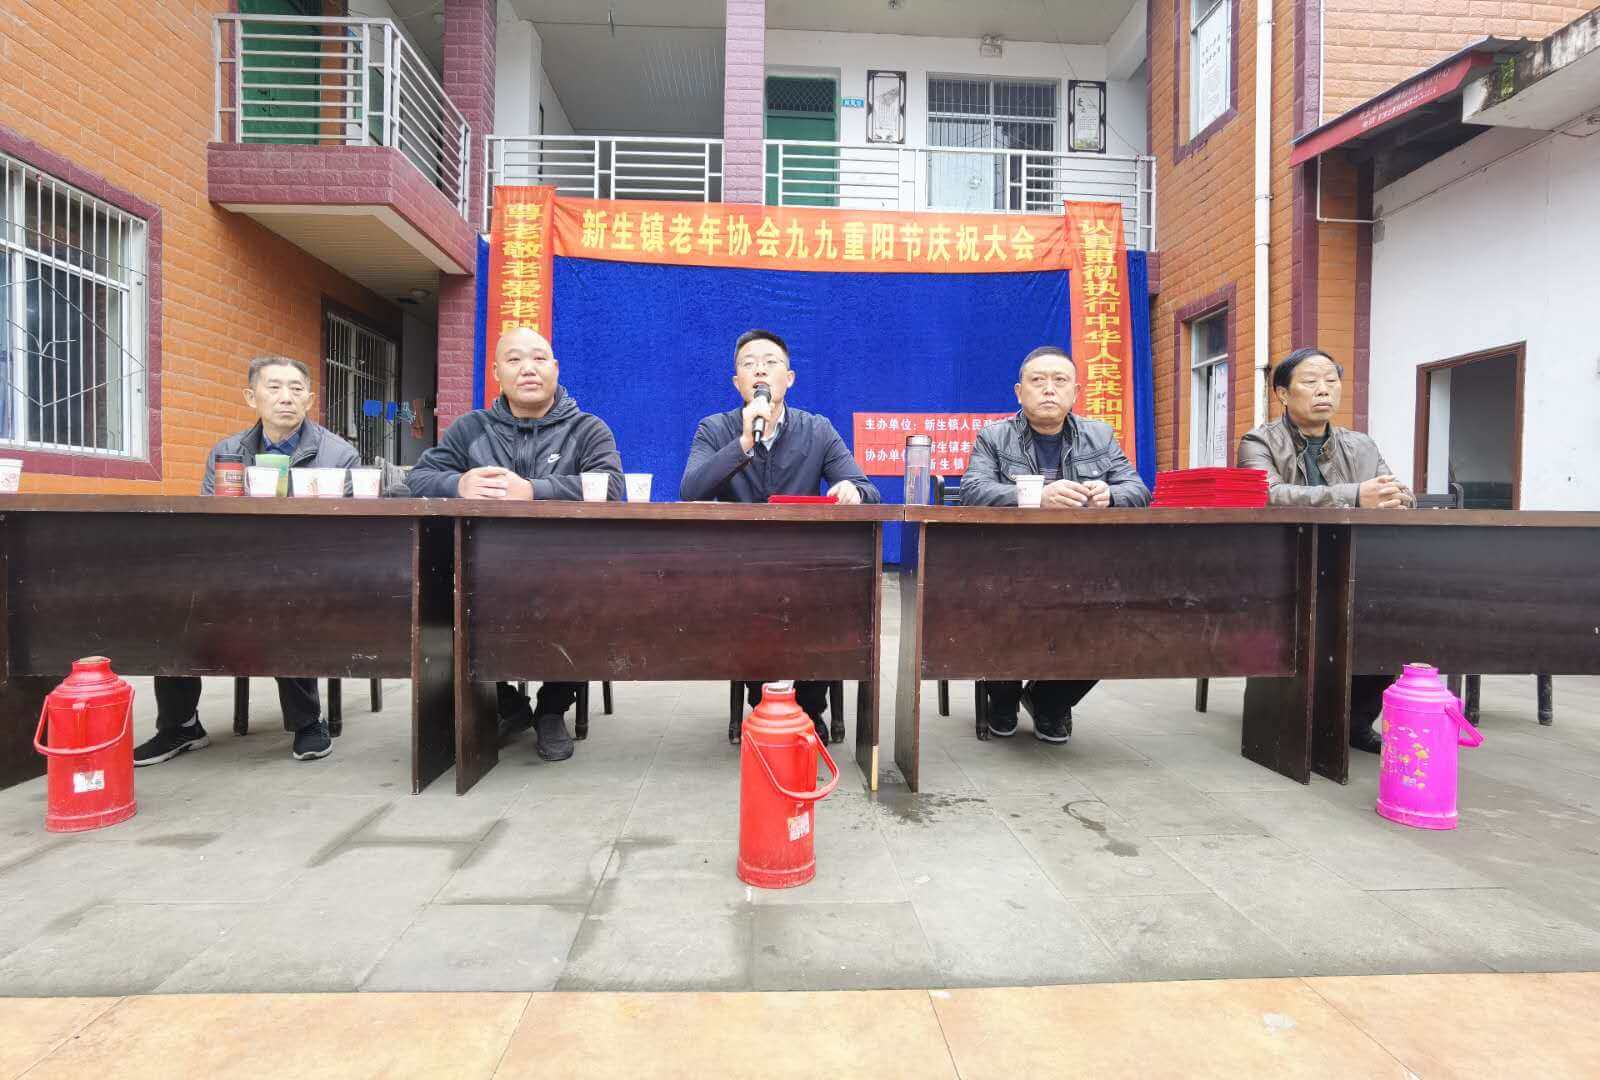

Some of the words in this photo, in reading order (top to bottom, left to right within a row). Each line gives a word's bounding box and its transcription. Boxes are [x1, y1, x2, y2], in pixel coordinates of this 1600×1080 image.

[582, 208, 1036, 263] 新生镇老年协会九九重阳节庆祝大会
[1081, 219, 1122, 440] 认真贯彻执行中华人民共和国
